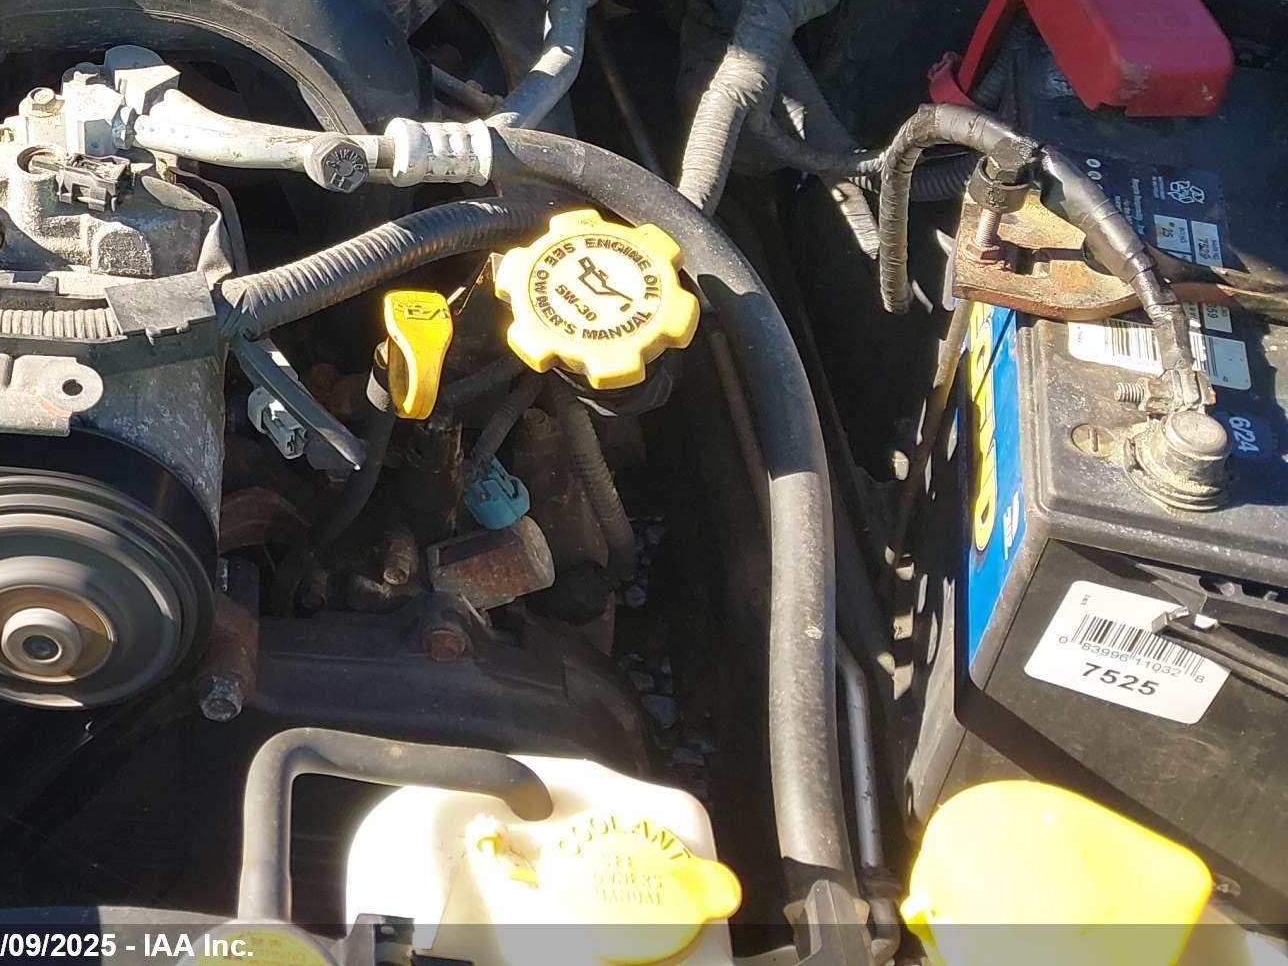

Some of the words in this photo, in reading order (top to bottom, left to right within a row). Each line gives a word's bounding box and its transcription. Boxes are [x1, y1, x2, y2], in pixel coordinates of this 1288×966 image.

[544, 242, 576, 267] SEE
[584, 237, 652, 272] ENGINE
[643, 274, 660, 301] OIL
[534, 269, 578, 335] OWNER'S
[555, 284, 597, 322] 5W-30
[582, 310, 653, 341] MANUAL
[1058, 635, 1069, 645] 0
[1080, 642, 1130, 663] 83996
[1135, 657, 1183, 678] 11032
[1194, 674, 1206, 684] 8
[1081, 661, 1161, 696] 7525
[557, 814, 693, 861] COOLANT
